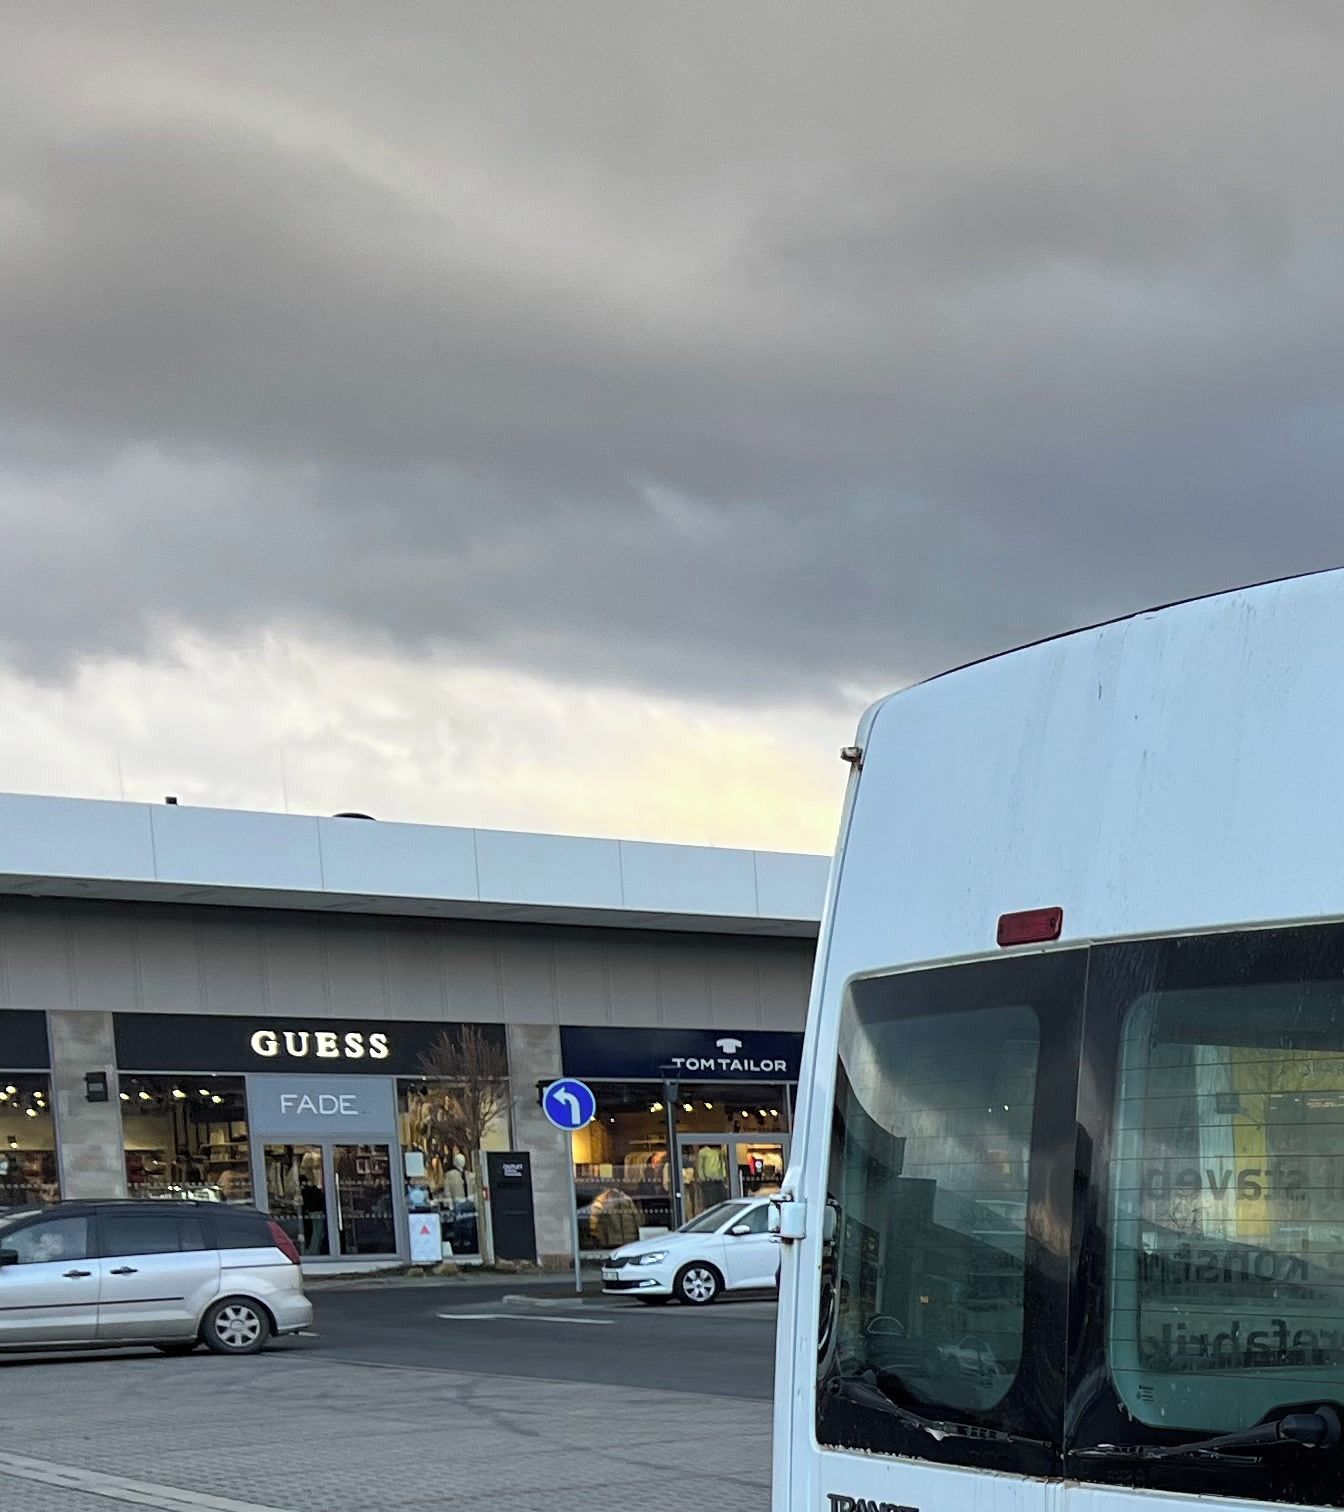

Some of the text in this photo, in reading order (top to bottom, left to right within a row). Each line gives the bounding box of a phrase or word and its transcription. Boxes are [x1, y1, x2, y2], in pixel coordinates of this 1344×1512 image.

[251, 1030, 390, 1059] GUESS
[672, 1057, 787, 1072] TOM TAILOR
[280, 1094, 360, 1115] FADE
